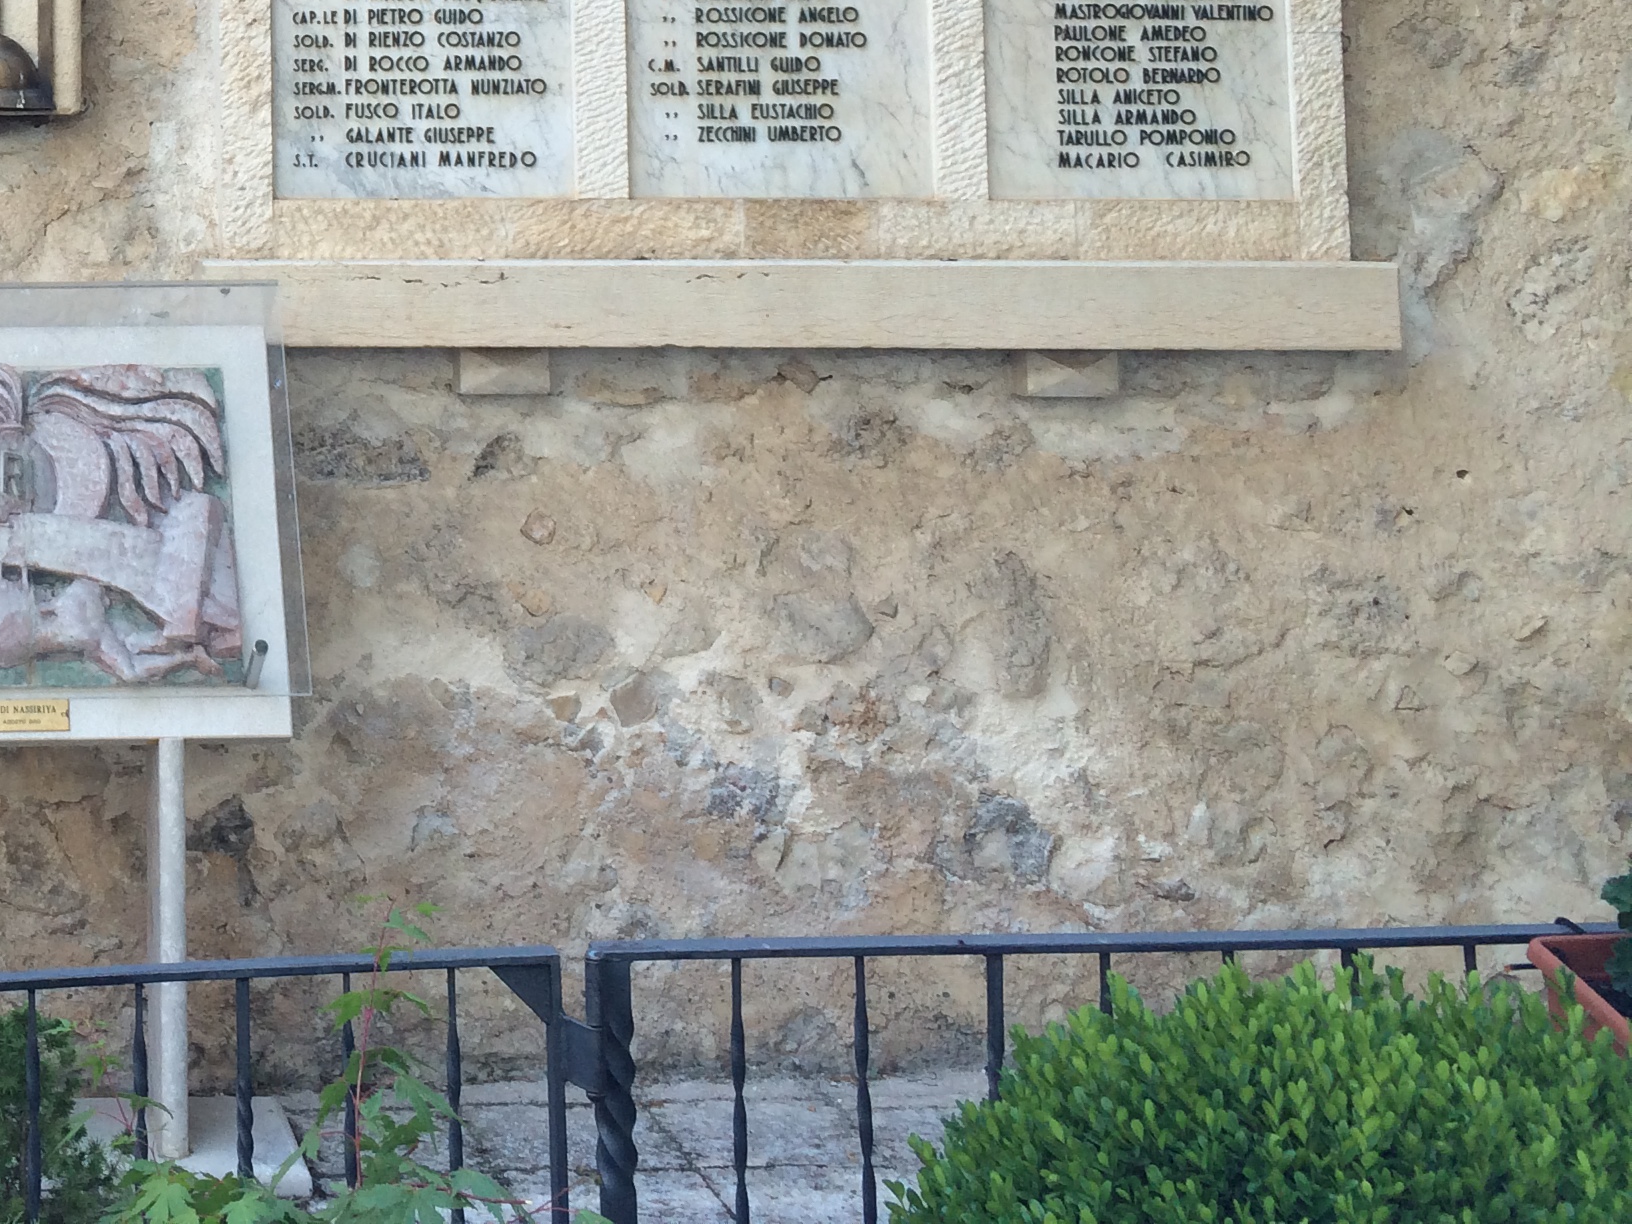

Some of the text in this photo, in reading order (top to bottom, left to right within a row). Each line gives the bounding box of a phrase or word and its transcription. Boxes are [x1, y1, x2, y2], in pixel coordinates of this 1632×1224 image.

[294, 31, 521, 49] SOLD. DI RIENZO COSTANZO
[1056, 46, 1218, 63] RONCONE STEFANO
[293, 55, 522, 72] SERG. DI ROCCO ARMANDO
[648, 56, 820, 74] C.M. SANTILLI GUIDO
[1056, 67, 1221, 86] ROTOLO BERNARDO
[1058, 89, 1180, 105] SILLA ANICETO
[294, 103, 460, 119] SOLD. FUSCO ITALO
[1059, 109, 1196, 125] SILLA ARMANDO
[293, 151, 537, 168] S.T. CRUCIANI MANFREDO
[14, 705, 56, 713] NASSIRIYA
